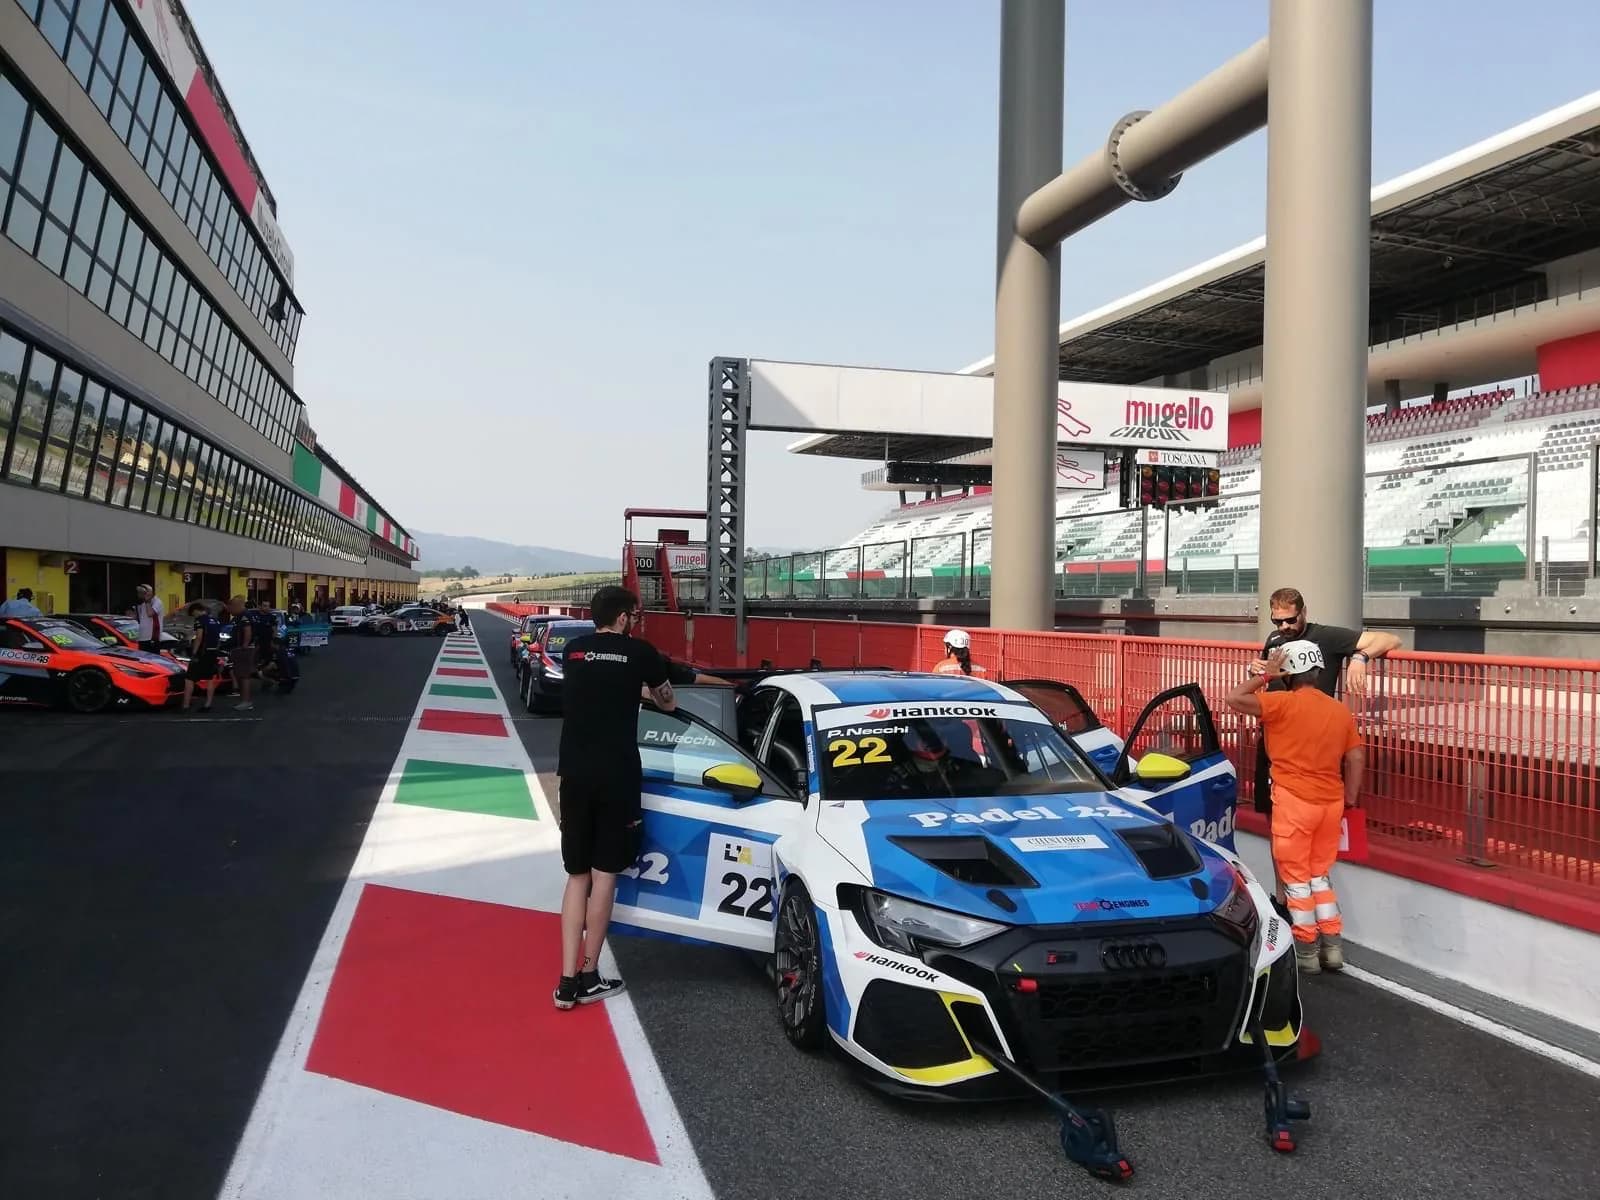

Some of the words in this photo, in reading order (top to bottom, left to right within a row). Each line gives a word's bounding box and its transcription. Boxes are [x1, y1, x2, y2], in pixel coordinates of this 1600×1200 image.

[1125, 397, 1214, 430] mugello
[1160, 452, 1207, 465] TOSCANA
[66, 561, 78, 574] 2
[675, 553, 706, 567] mugell
[184, 573, 191, 583] 3
[548, 637, 565, 645] 30
[828, 736, 893, 768] 22
[908, 806, 1064, 828] Padel
[1067, 805, 1134, 819] 22
[1190, 806, 1237, 843] Pad
[718, 872, 776, 922] 22
